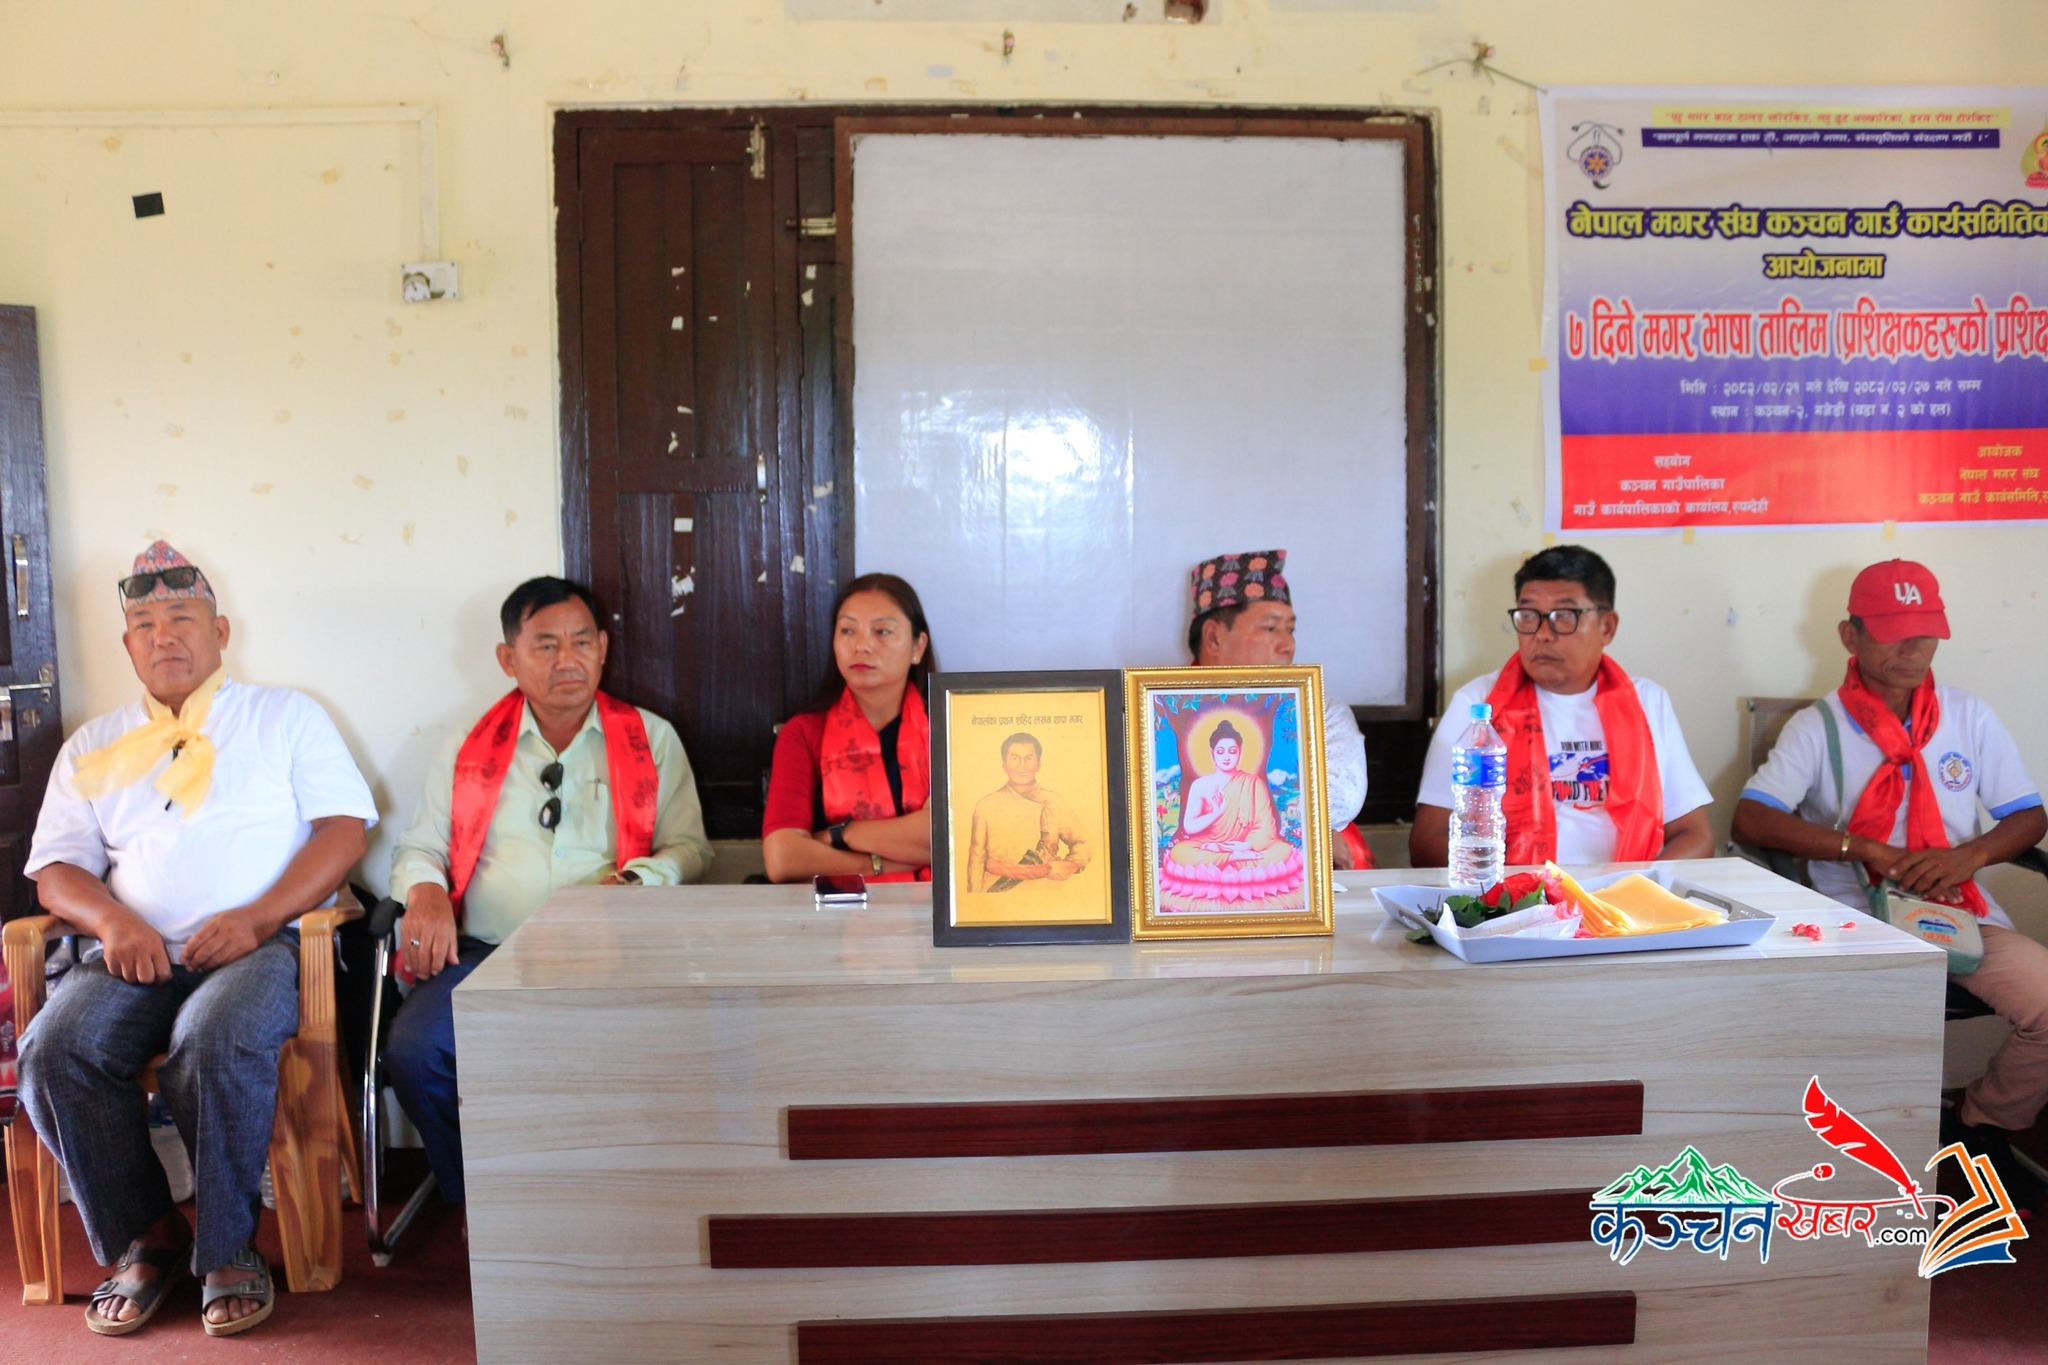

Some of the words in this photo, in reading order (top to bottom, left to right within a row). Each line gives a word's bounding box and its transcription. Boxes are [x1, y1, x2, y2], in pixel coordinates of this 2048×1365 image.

[1569, 203, 1643, 237] नेपाल
[1649, 207, 1711, 237] मगर
[1717, 203, 1760, 237] संघ
[1766, 207, 1848, 237] कञ्चन
[1854, 202, 1900, 237] गाउँ
[1764, 249, 1885, 279] आयोजनामा
[1569, 311, 1583, 356] ७
[1592, 297, 1635, 361] दिने
[1642, 312, 1695, 359] मगर
[1703, 310, 1751, 358] भाषा
[1759, 296, 1828, 358] तालिम
[1680, 378, 1707, 394] मिति
[1854, 380, 1930, 395] २०८२/०२/२७
[1711, 404, 1739, 419] स्थान
[1978, 444, 2023, 458] आयोजक
[1654, 453, 1691, 469] सहयोग
[1960, 466, 1989, 480] नेपाल
[1993, 468, 2018, 481] मगर
[2022, 466, 2040, 479] संघ
[1619, 479, 1657, 492] कञ्चन
[1894, 582, 1922, 605] UA
